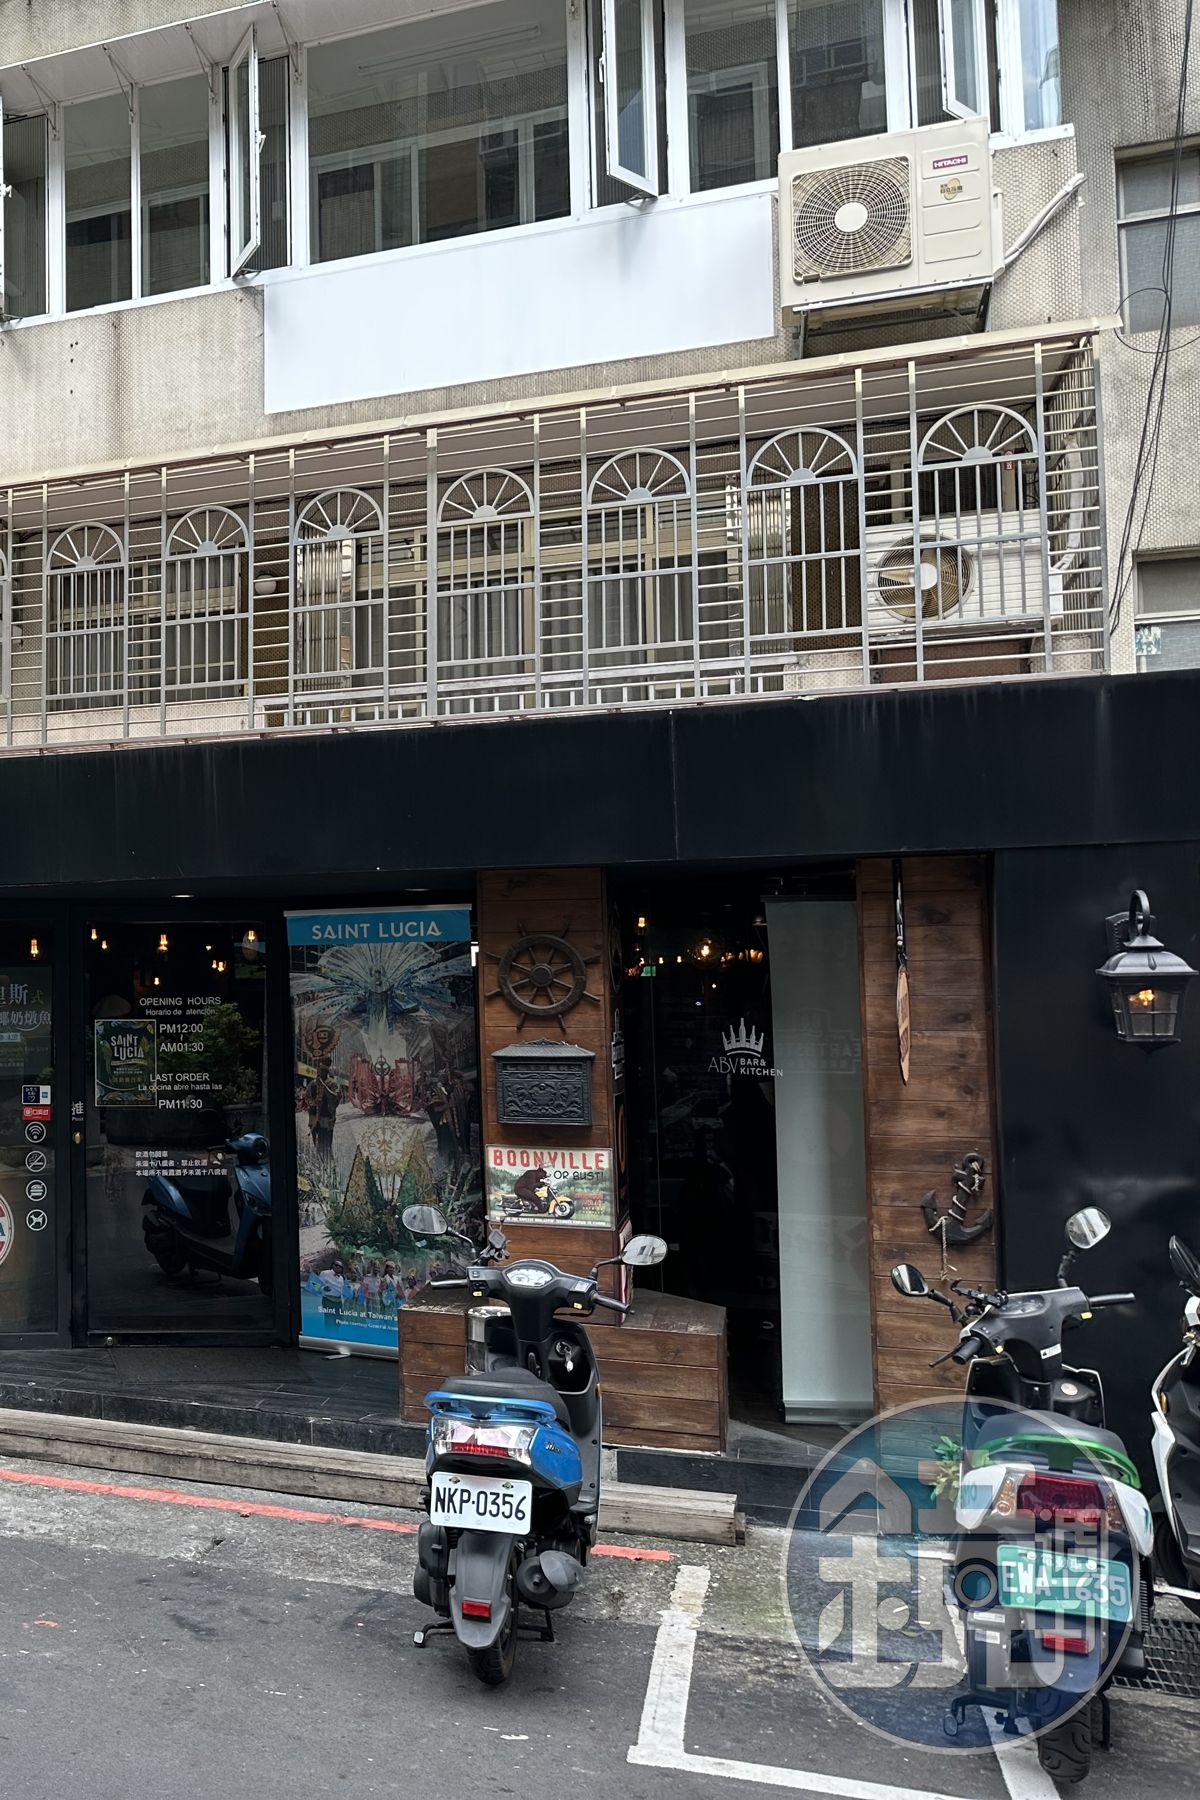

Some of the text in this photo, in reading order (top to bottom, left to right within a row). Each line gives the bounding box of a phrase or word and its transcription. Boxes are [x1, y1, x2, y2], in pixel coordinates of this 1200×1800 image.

[934, 157, 967, 168] HITACHI
[311, 920, 443, 940] SAINT LUCIA
[140, 996, 222, 1006] OPENING HOURS
[145, 1008, 172, 1016] Horario
[159, 1023, 204, 1033] PM12:00
[110, 1033, 139, 1047] SAINT
[159, 1042, 204, 1052] AM01:30
[114, 1046, 145, 1060] LUCIA
[707, 1056, 739, 1074] ABV
[149, 1073, 173, 1081] LAST
[175, 1072, 210, 1081] ORDER
[740, 1067, 784, 1077] KITCHEN
[71, 1100, 84, 1116] 推
[158, 1099, 203, 1109] PM11:30
[493, 1148, 605, 1170] BOONVILLE
[553, 1170, 569, 1180] OR
[317, 1305, 336, 1314] Saint
[339, 1308, 358, 1317] Lucia
[434, 1486, 527, 1521] NKP-0356
[1001, 1561, 1126, 1607] EWA-1635
